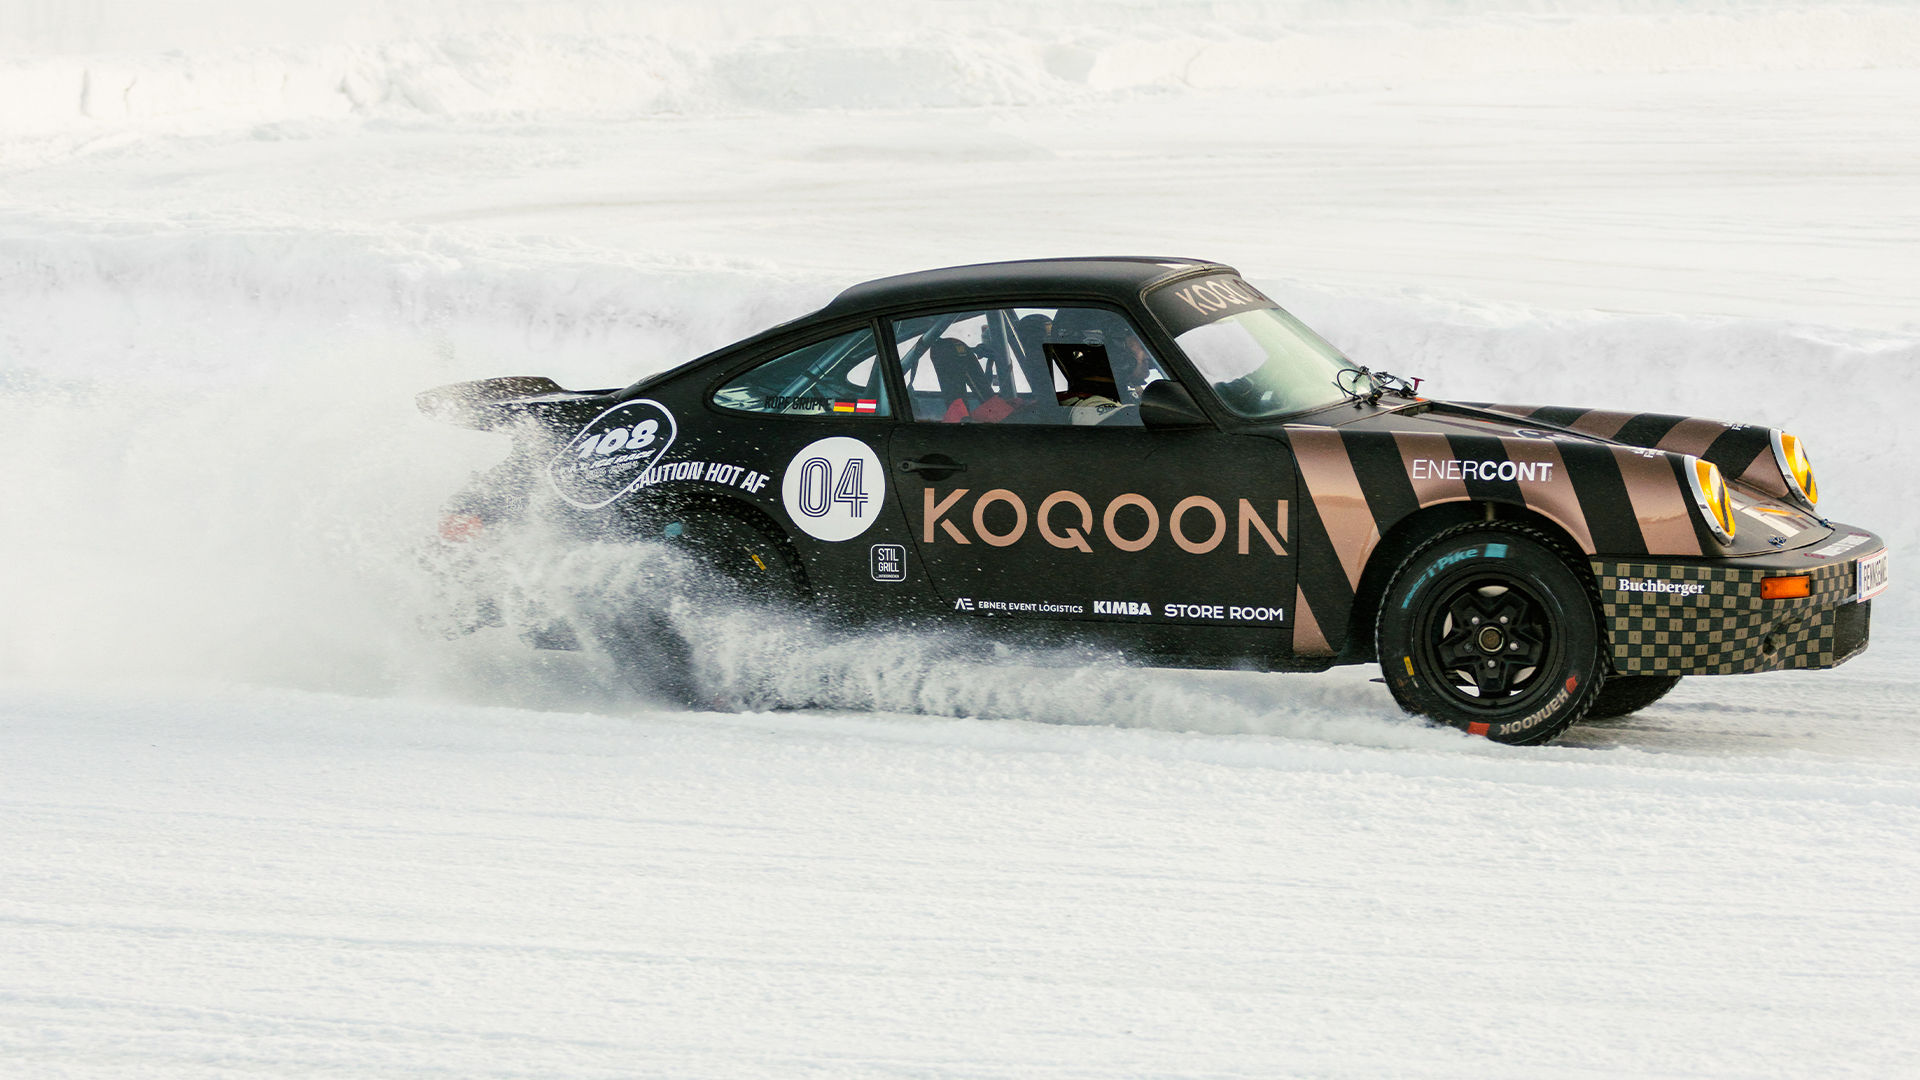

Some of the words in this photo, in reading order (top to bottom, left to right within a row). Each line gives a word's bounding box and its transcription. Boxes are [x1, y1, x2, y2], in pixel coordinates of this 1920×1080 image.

[764, 395, 791, 410] KOPF
[577, 418, 659, 459] 108
[629, 461, 703, 493] CAUTION
[704, 463, 745, 486] HOT
[739, 470, 770, 494] AF
[1412, 459, 1553, 481] ENERCONT
[798, 456, 868, 518] 04
[923, 487, 1289, 556] KOQOON
[878, 548, 899, 561] STIL
[878, 562, 900, 573] GRILL
[1619, 579, 1705, 597] Buchberger
[978, 600, 1007, 610] EBNER
[1008, 602, 1037, 612] EVENT
[1039, 603, 1083, 614] LOGISTICS
[1093, 600, 1152, 615] KIMBA
[1164, 603, 1224, 619] STORE
[1229, 606, 1284, 622] ROOM
